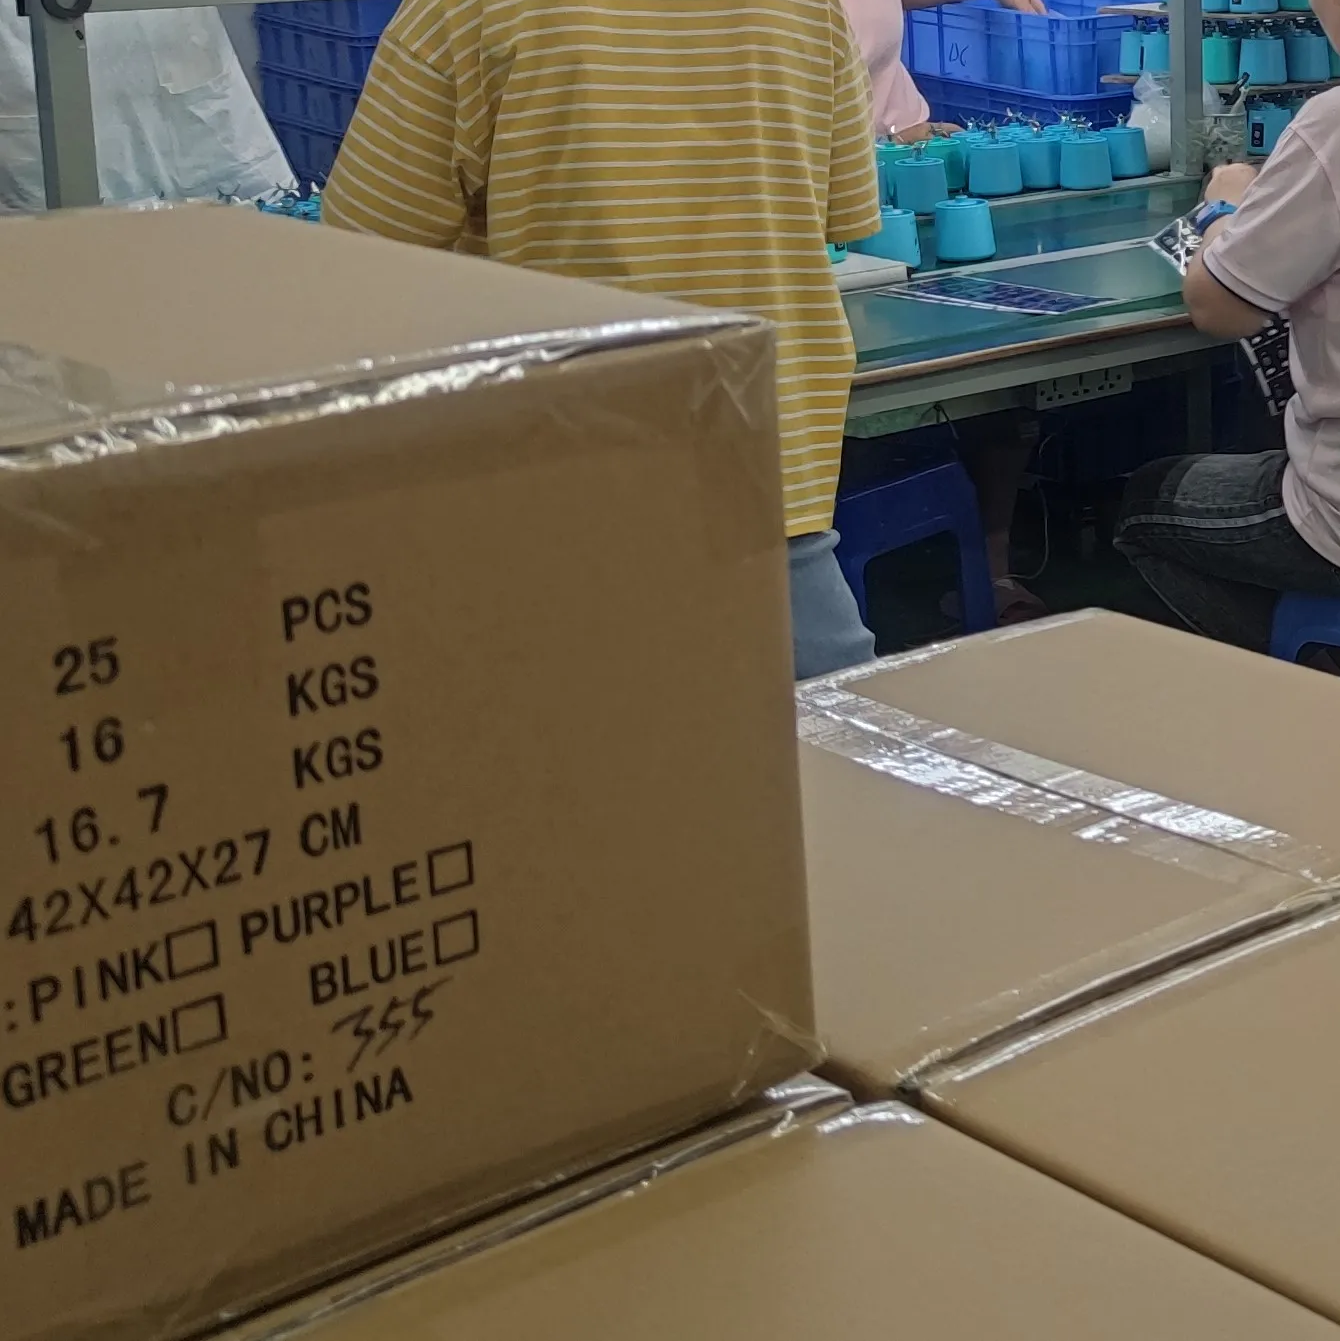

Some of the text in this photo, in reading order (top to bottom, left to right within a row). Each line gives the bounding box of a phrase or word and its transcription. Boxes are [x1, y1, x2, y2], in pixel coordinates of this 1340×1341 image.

[53, 581, 373, 697] 25 PCS
[60, 655, 380, 773] 16 KGS
[291, 726, 384, 790] KGS
[6, 800, 363, 944] 42X42X27 CM
[239, 860, 422, 955] PURPLE
[1, 928, 427, 1110] GREEN BLUE
[166, 1048, 315, 1127] C/NO:
[13, 1066, 414, 1250] MADE IN CHINA
